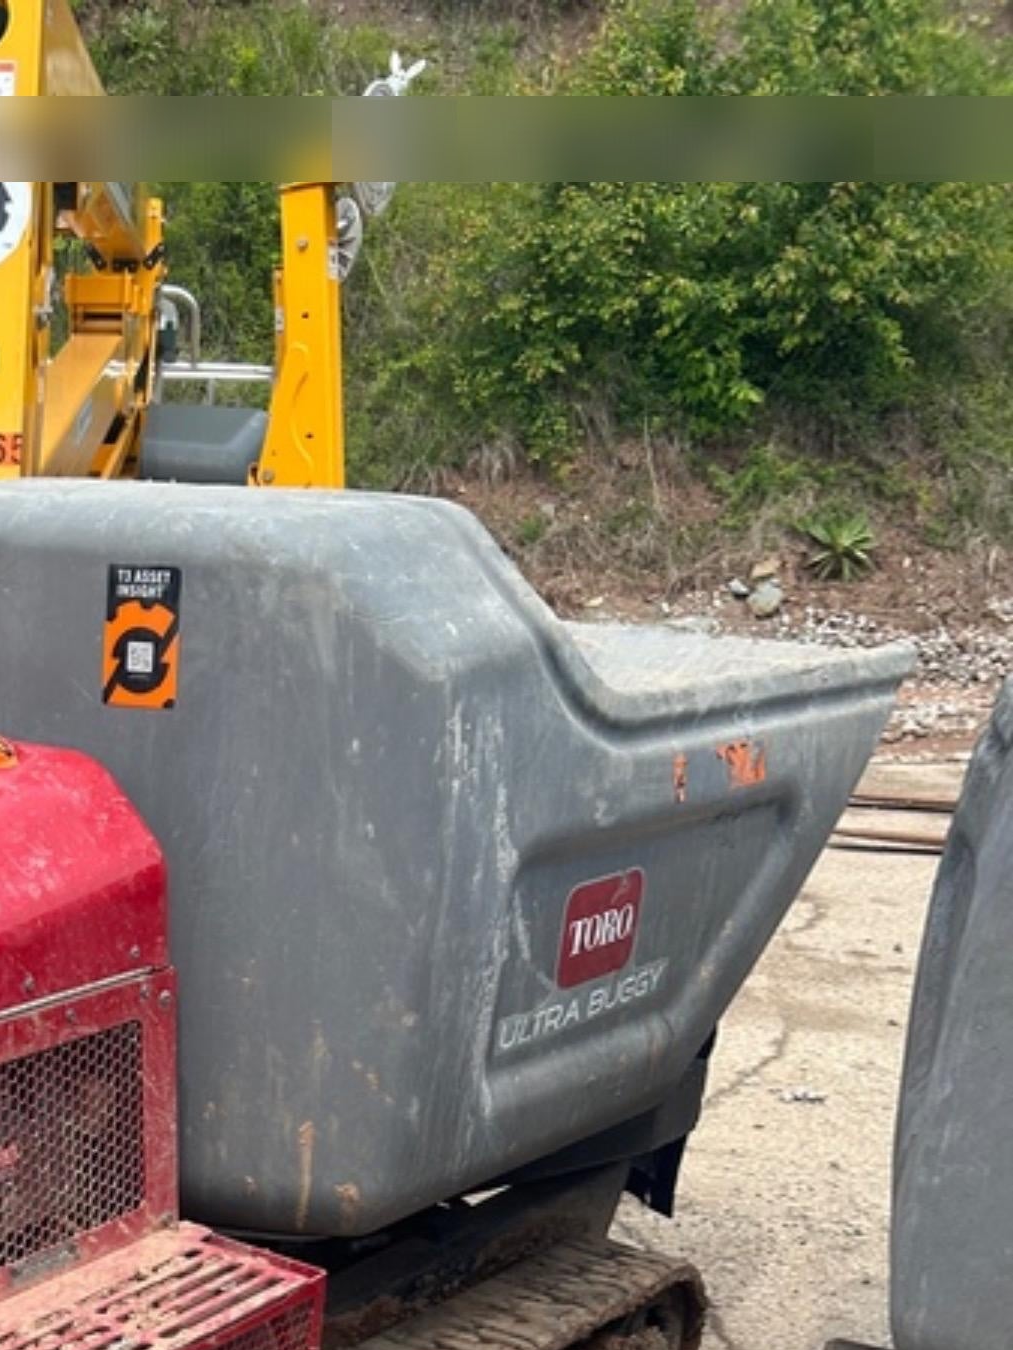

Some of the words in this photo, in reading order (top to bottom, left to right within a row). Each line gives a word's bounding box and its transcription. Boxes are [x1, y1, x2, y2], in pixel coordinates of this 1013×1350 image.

[134, 569, 171, 583] ASSET
[569, 904, 634, 957] TORO
[499, 1000, 580, 1049] ULTRA
[587, 960, 667, 1017] BUGGY
